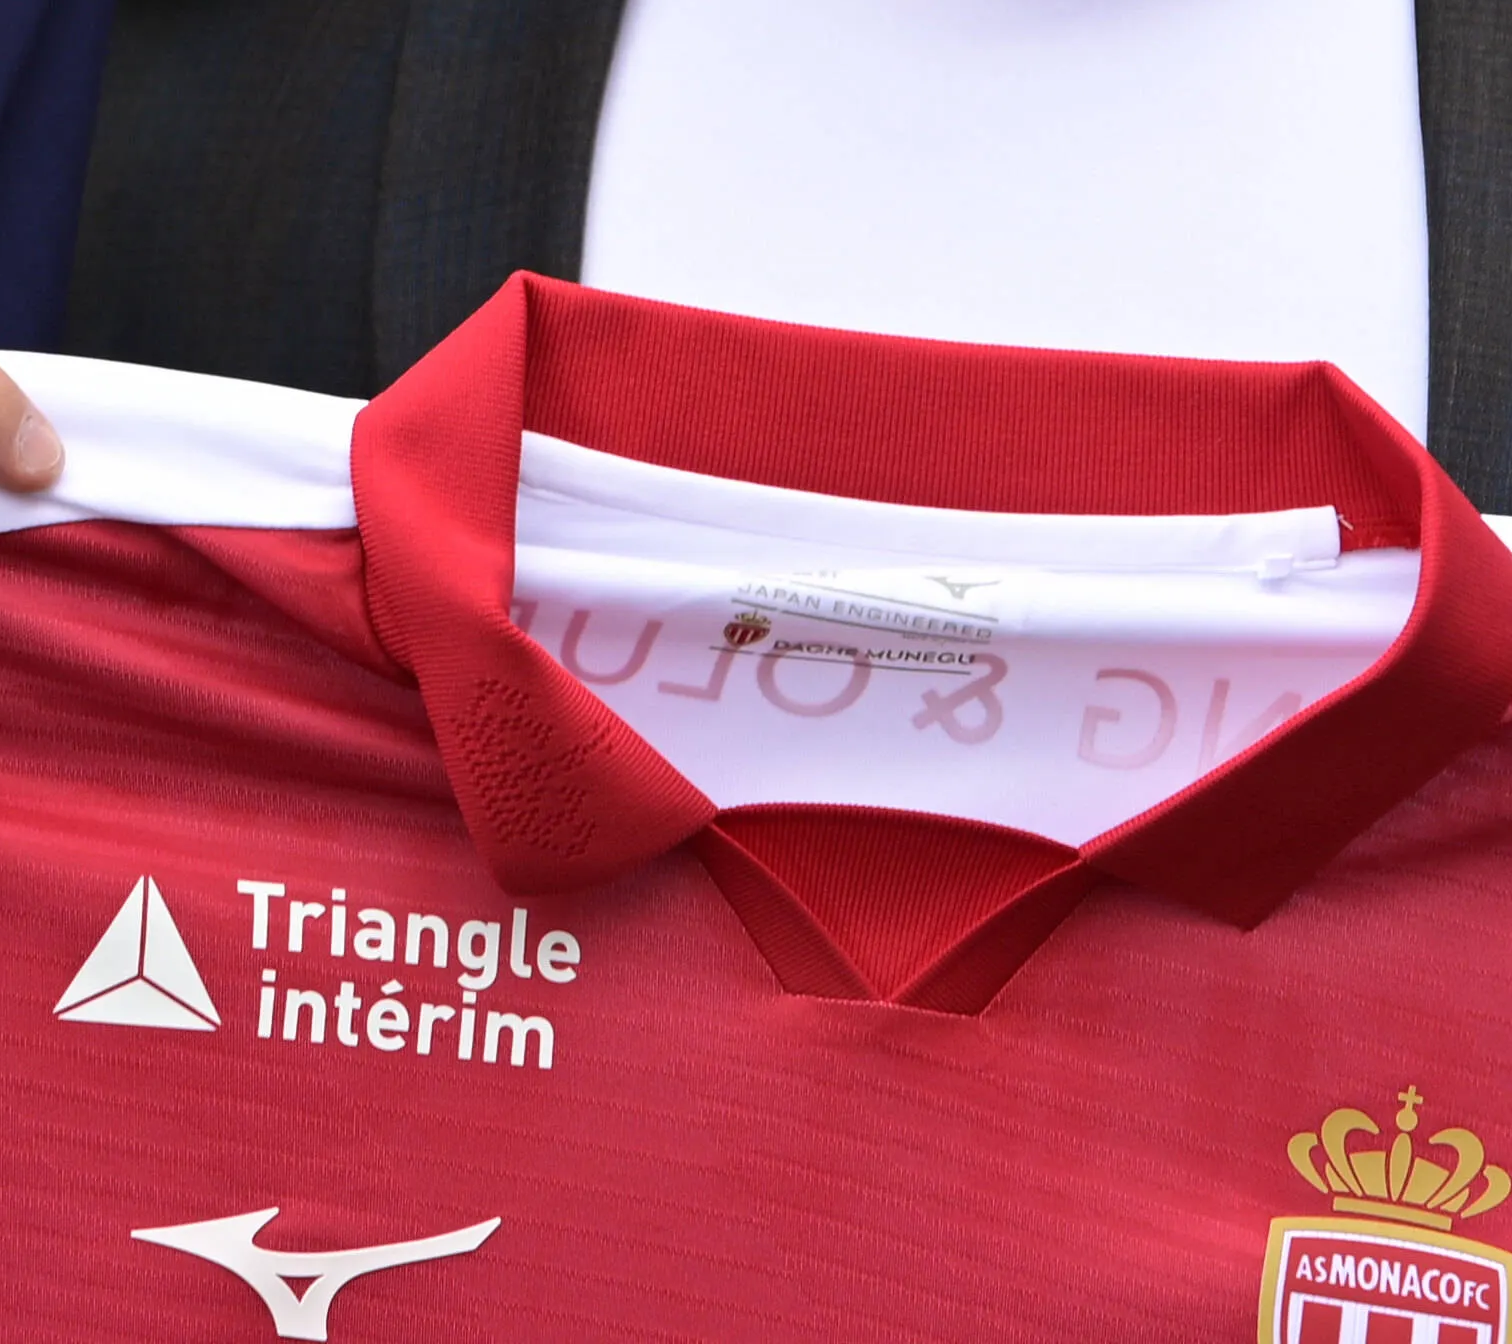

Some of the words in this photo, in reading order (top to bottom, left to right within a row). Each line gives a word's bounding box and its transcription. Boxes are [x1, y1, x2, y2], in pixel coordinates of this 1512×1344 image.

[737, 582, 821, 610] JAPAN
[833, 600, 993, 640] ENGINEERED
[236, 879, 582, 991] Triangle
[257, 968, 555, 1069] intérim
